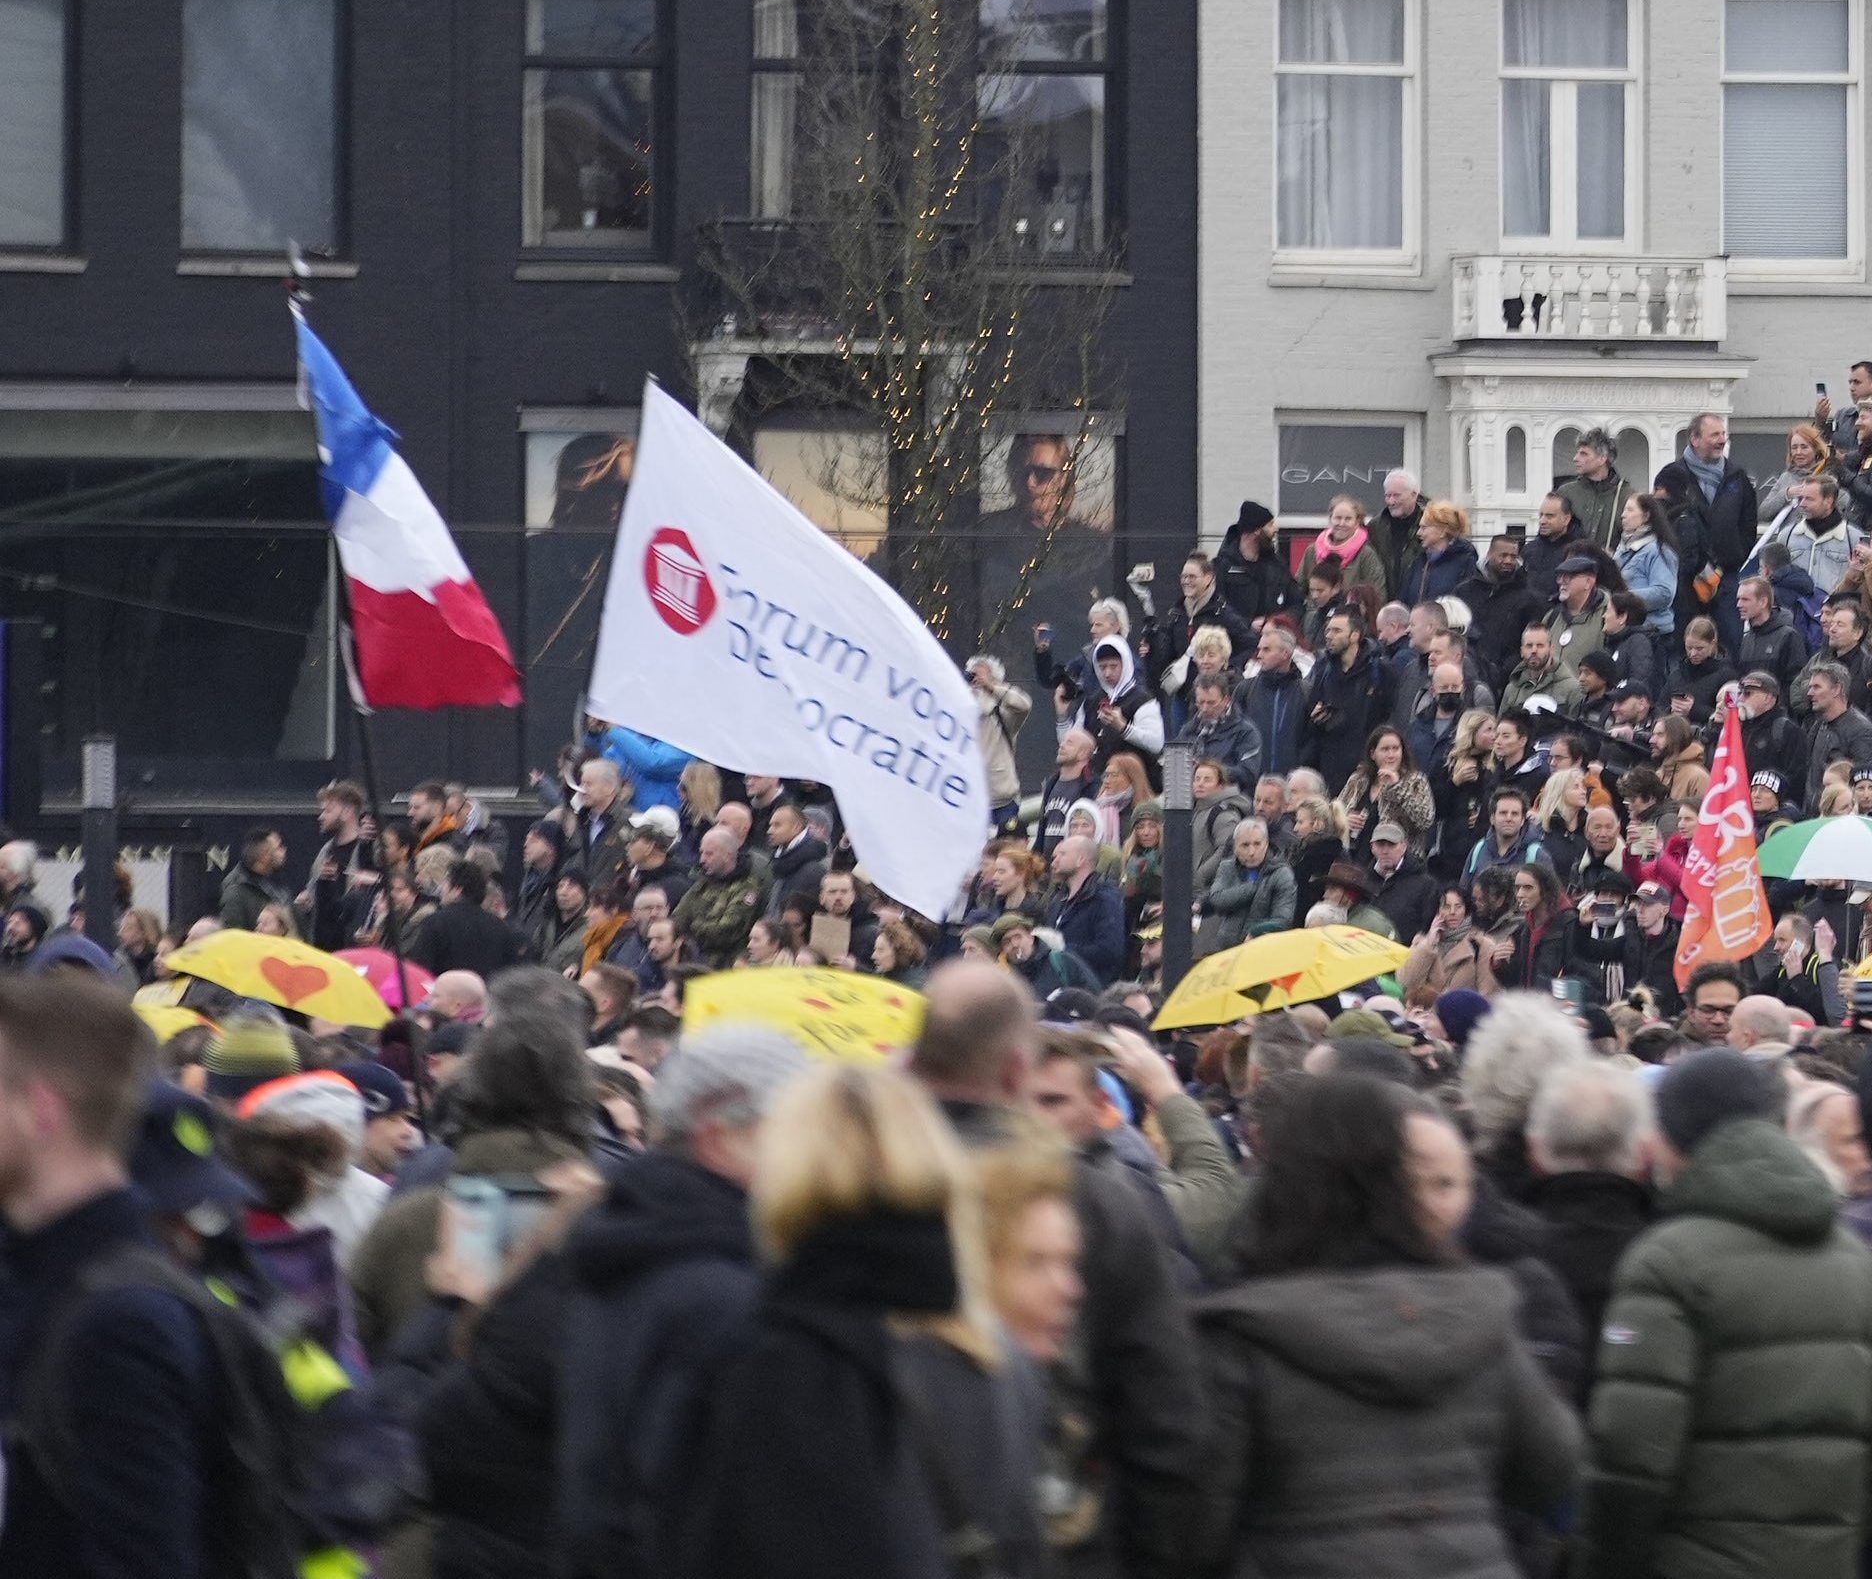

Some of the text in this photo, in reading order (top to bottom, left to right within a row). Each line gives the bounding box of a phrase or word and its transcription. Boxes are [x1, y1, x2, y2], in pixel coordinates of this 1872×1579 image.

[1281, 466, 1395, 485] GANT
[726, 620, 969, 808] Deocratie
[886, 666, 976, 755] voor
